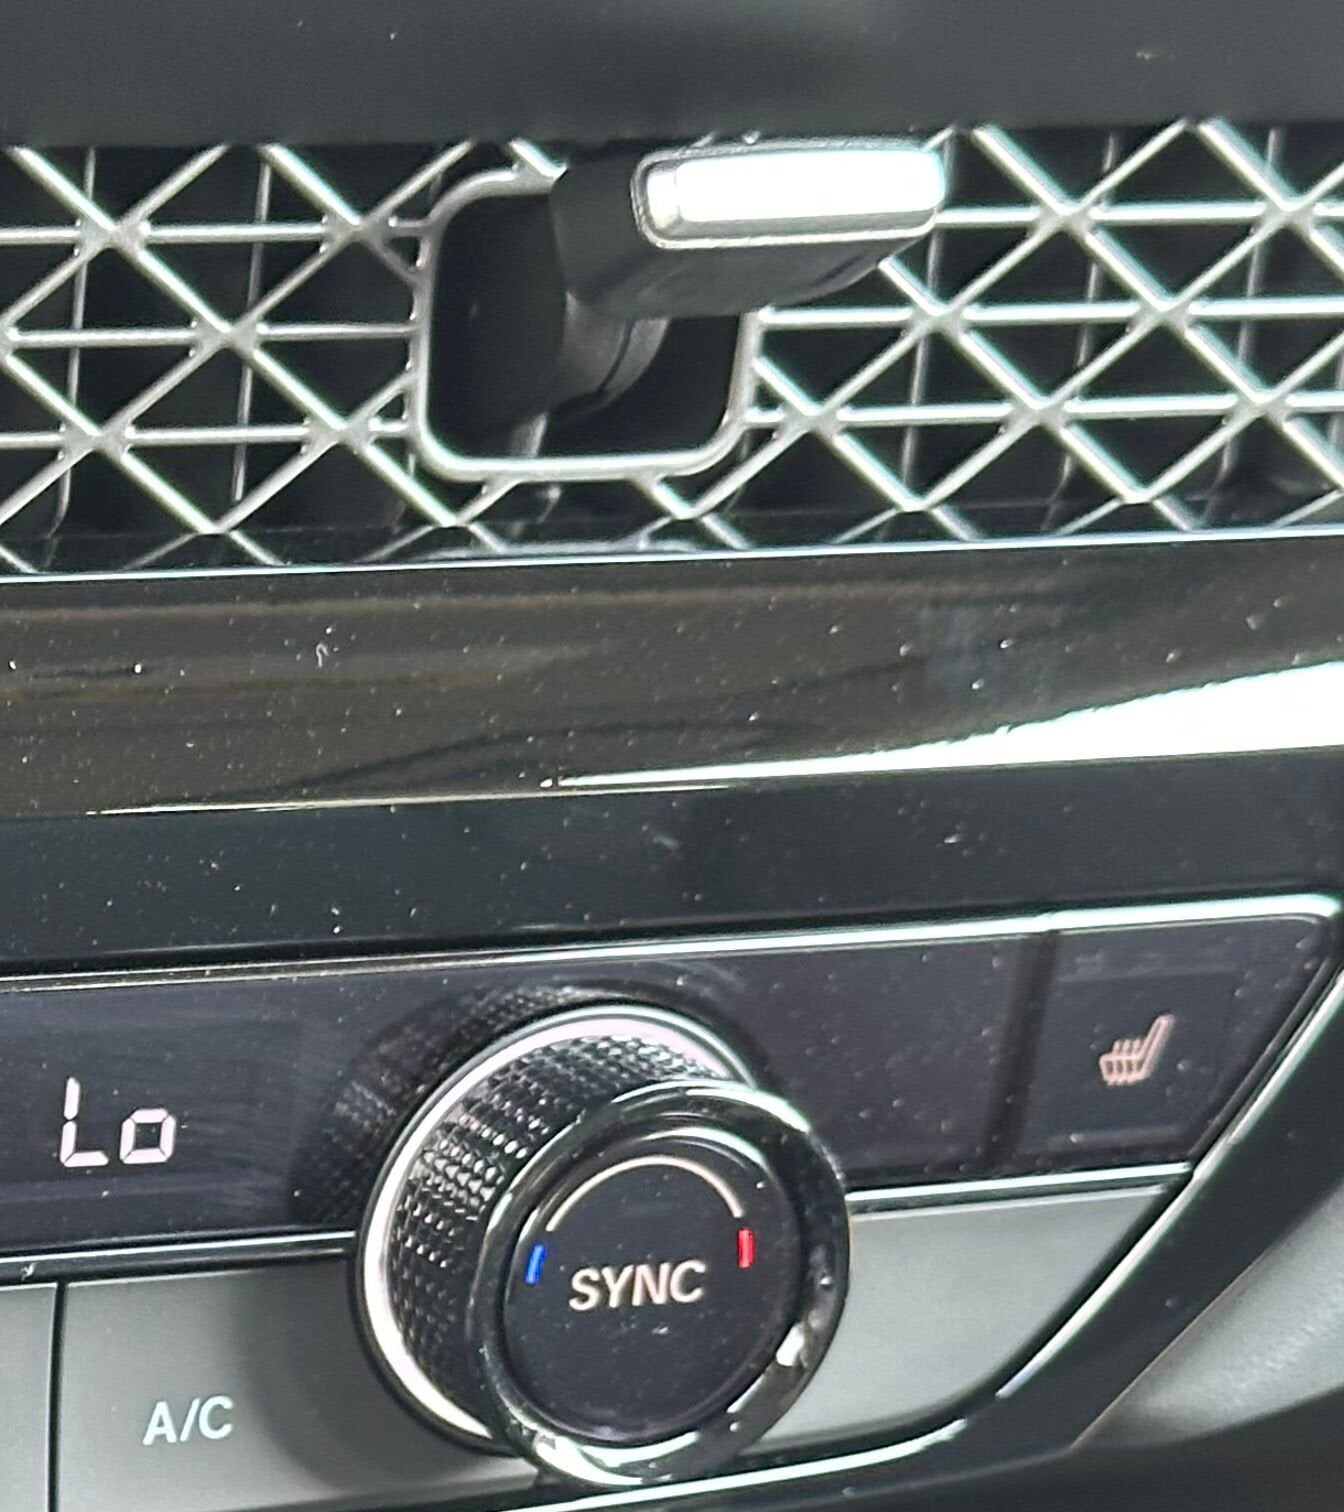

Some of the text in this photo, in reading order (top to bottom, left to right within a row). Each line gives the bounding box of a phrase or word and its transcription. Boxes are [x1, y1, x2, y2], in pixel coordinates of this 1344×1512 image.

[59, 1075, 178, 1169] Lo
[567, 1258, 707, 1313] SYNC
[142, 1395, 235, 1447] A/C
